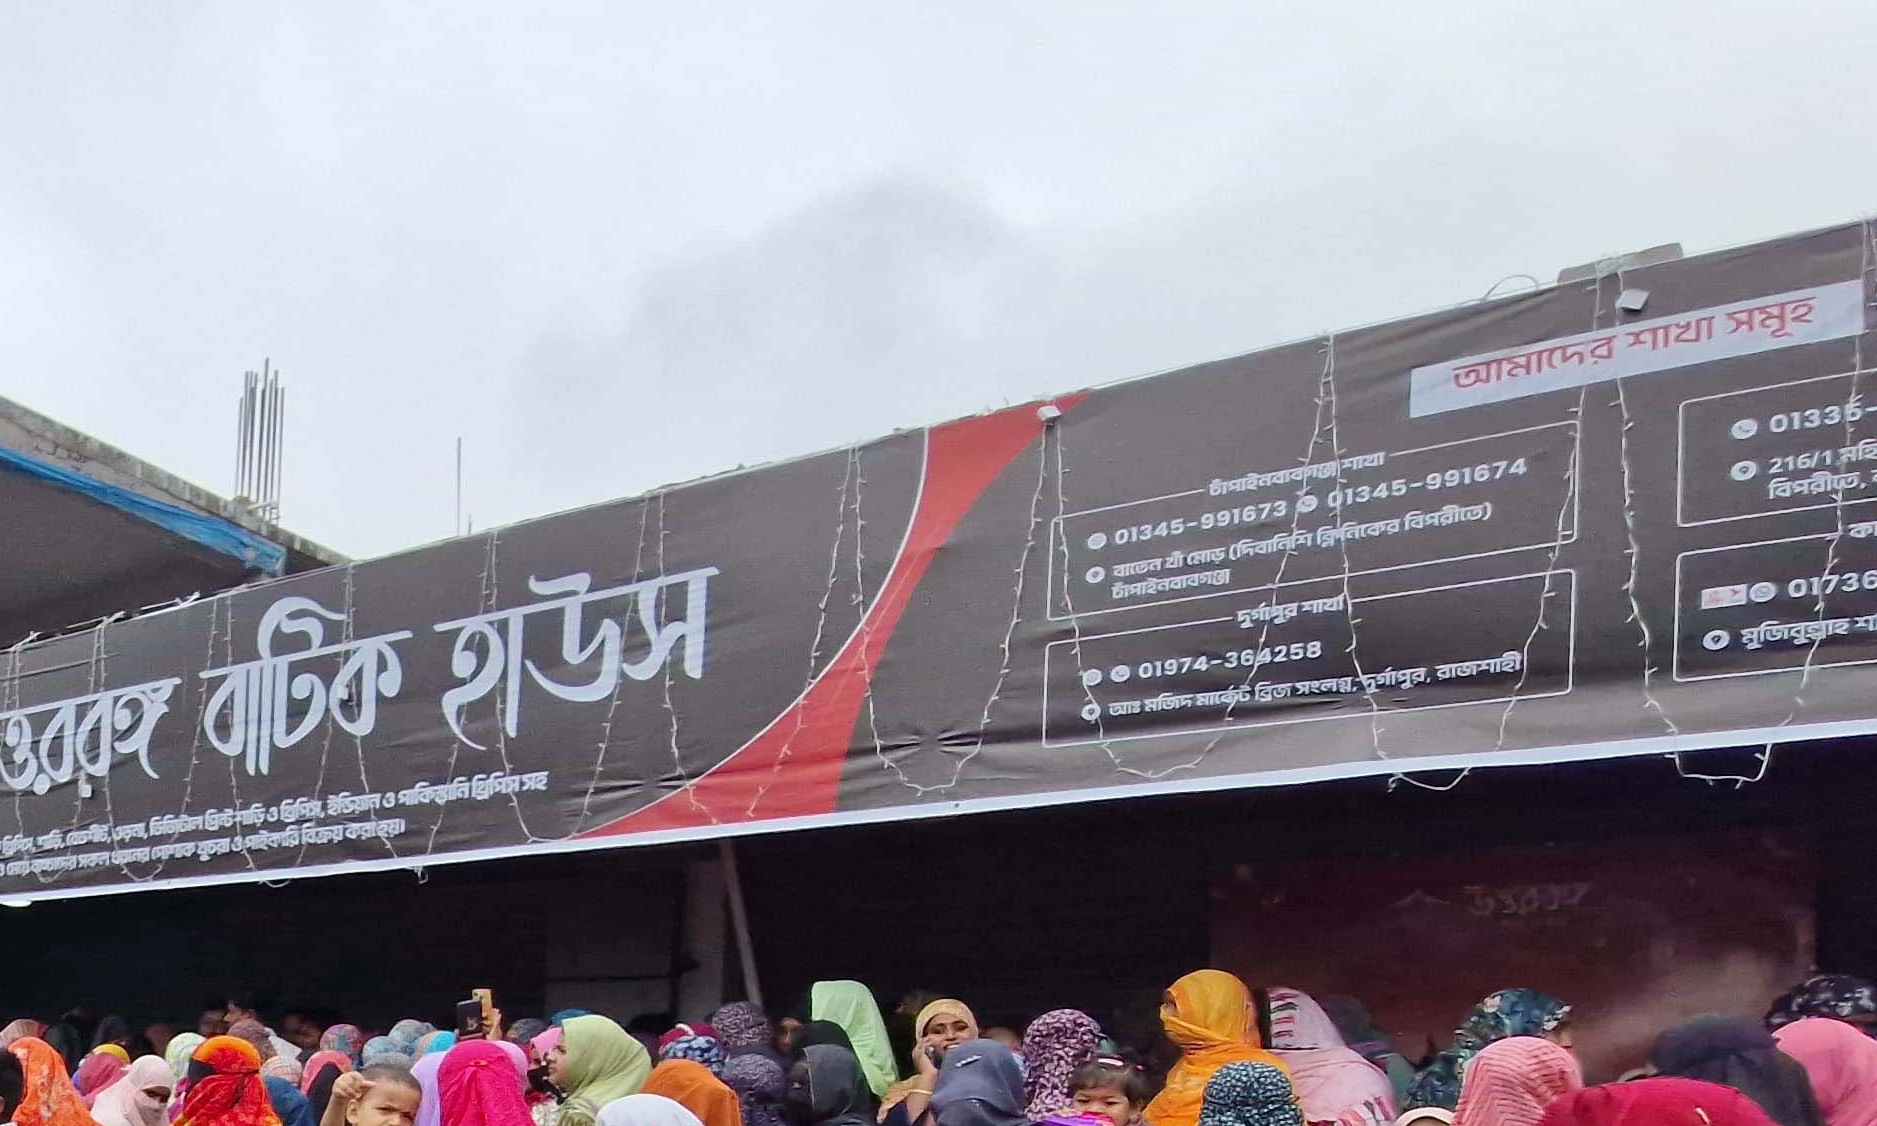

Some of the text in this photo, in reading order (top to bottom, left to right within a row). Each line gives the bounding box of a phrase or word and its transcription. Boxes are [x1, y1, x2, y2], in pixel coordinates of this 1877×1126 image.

[1452, 296, 1817, 389] আমাদের শাখা সমূহ
[1209, 452, 1386, 496] চাঁপাইনবাবগঞ্জ শাখা
[1768, 451, 1833, 474] 216/1
[1114, 458, 1527, 545] 01345-991673 01345-991674
[1186, 547, 1225, 569] মোড়
[1404, 502, 1493, 532] বিপরীতে)
[1111, 568, 1231, 599] চাঁপাইনবাবগঞ্জ
[1237, 597, 1345, 629] দুর্গাপুর শাখা
[199, 596, 413, 777] বাটিক
[433, 567, 719, 751] হাউস
[1138, 641, 1322, 679] 01974-364258
[1144, 692, 1193, 713] মজিদ
[1435, 651, 1523, 681] রাজশাহী
